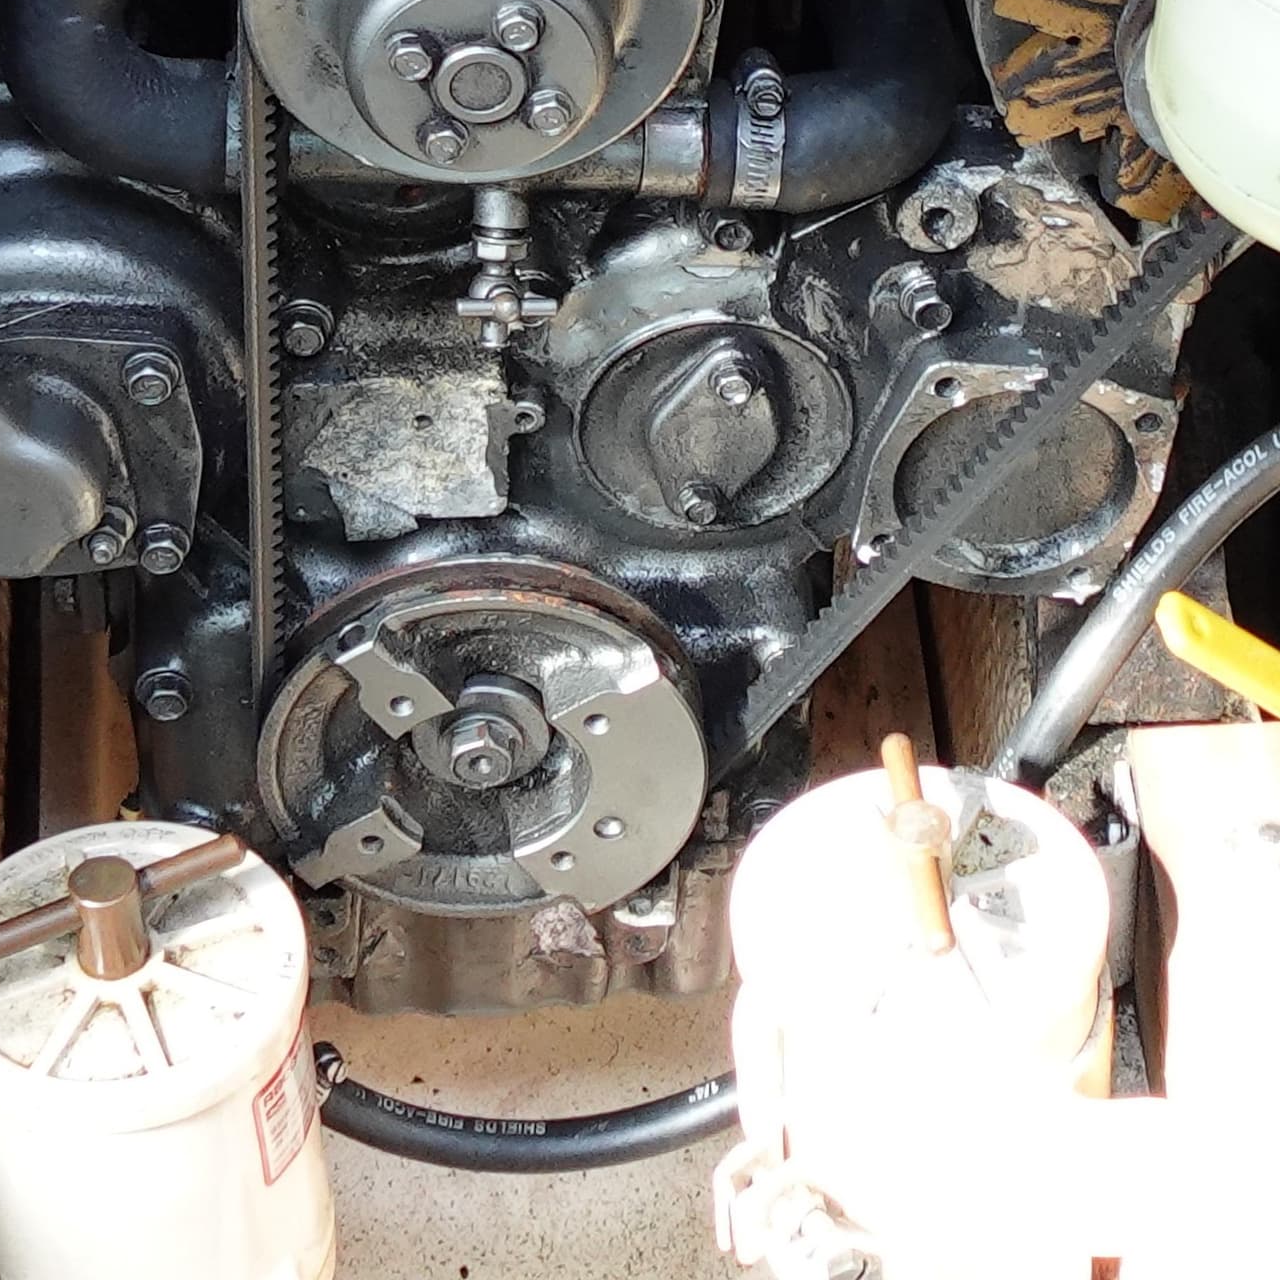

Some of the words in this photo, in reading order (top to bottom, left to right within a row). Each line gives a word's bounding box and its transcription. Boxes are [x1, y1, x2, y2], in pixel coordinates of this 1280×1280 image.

[1113, 528, 1176, 603] SHIELDS
[1179, 444, 1268, 525] FIRE-ACOL
[688, 1079, 719, 1101] 1/4"
[472, 1119, 545, 1135] SHIELDS
